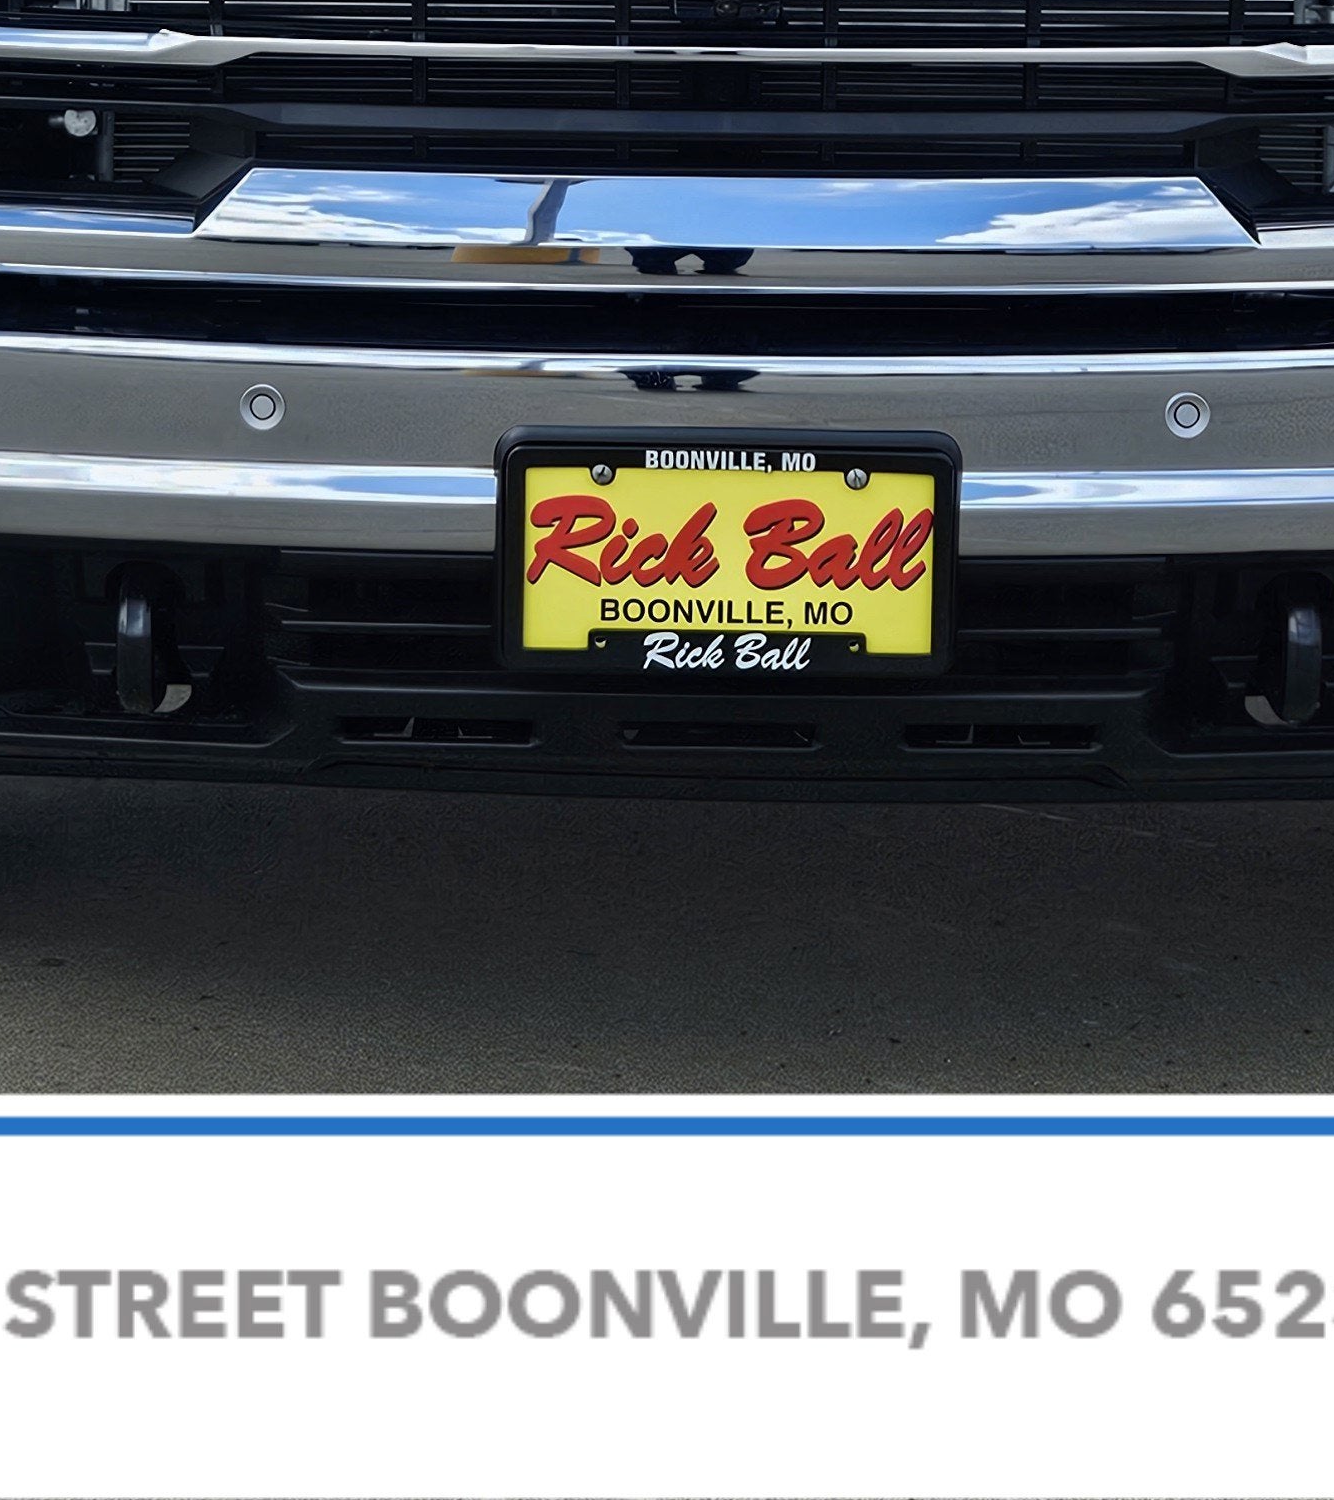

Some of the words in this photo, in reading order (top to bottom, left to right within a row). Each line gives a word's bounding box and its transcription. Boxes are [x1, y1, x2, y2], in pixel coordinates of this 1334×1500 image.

[644, 449, 774, 474] BOONVILLE,
[780, 452, 817, 473] MO
[525, 494, 721, 589] Rick
[742, 498, 935, 591] Ball
[599, 597, 794, 629] BOONVILLE,
[803, 600, 854, 626] MO
[642, 631, 726, 670] Rick
[733, 631, 812, 671] Ball
